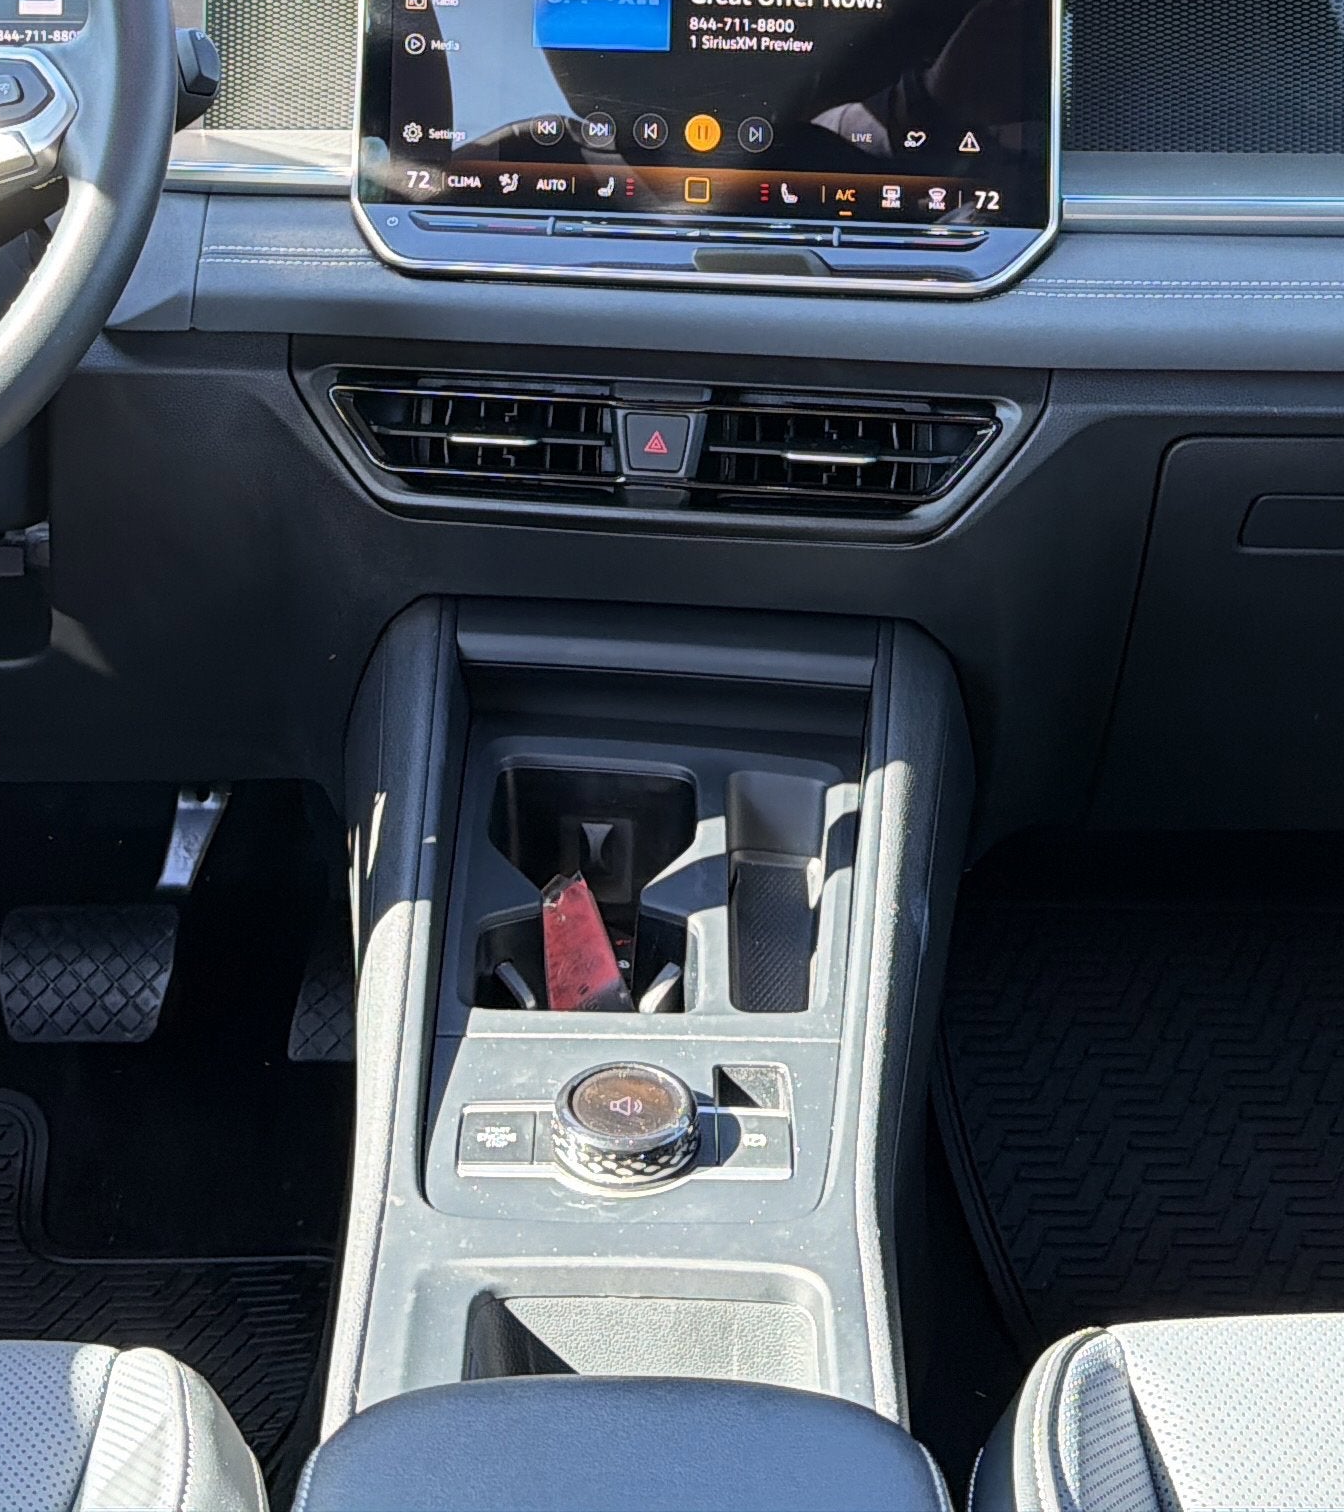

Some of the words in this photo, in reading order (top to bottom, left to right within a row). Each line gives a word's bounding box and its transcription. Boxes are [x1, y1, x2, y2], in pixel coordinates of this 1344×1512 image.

[689, 18, 795, 33] 844-711-8800
[430, 39, 460, 51] Media
[690, 36, 697, 49] 1
[701, 36, 757, 50] SiriusXM
[761, 38, 813, 52] Preview
[428, 128, 466, 141] Settings
[851, 133, 873, 143] LIVE
[407, 171, 430, 188] 72
[447, 176, 482, 188] CLIMA
[536, 179, 567, 191] AUTO
[835, 189, 856, 202] A/C
[974, 191, 1000, 210] 72
